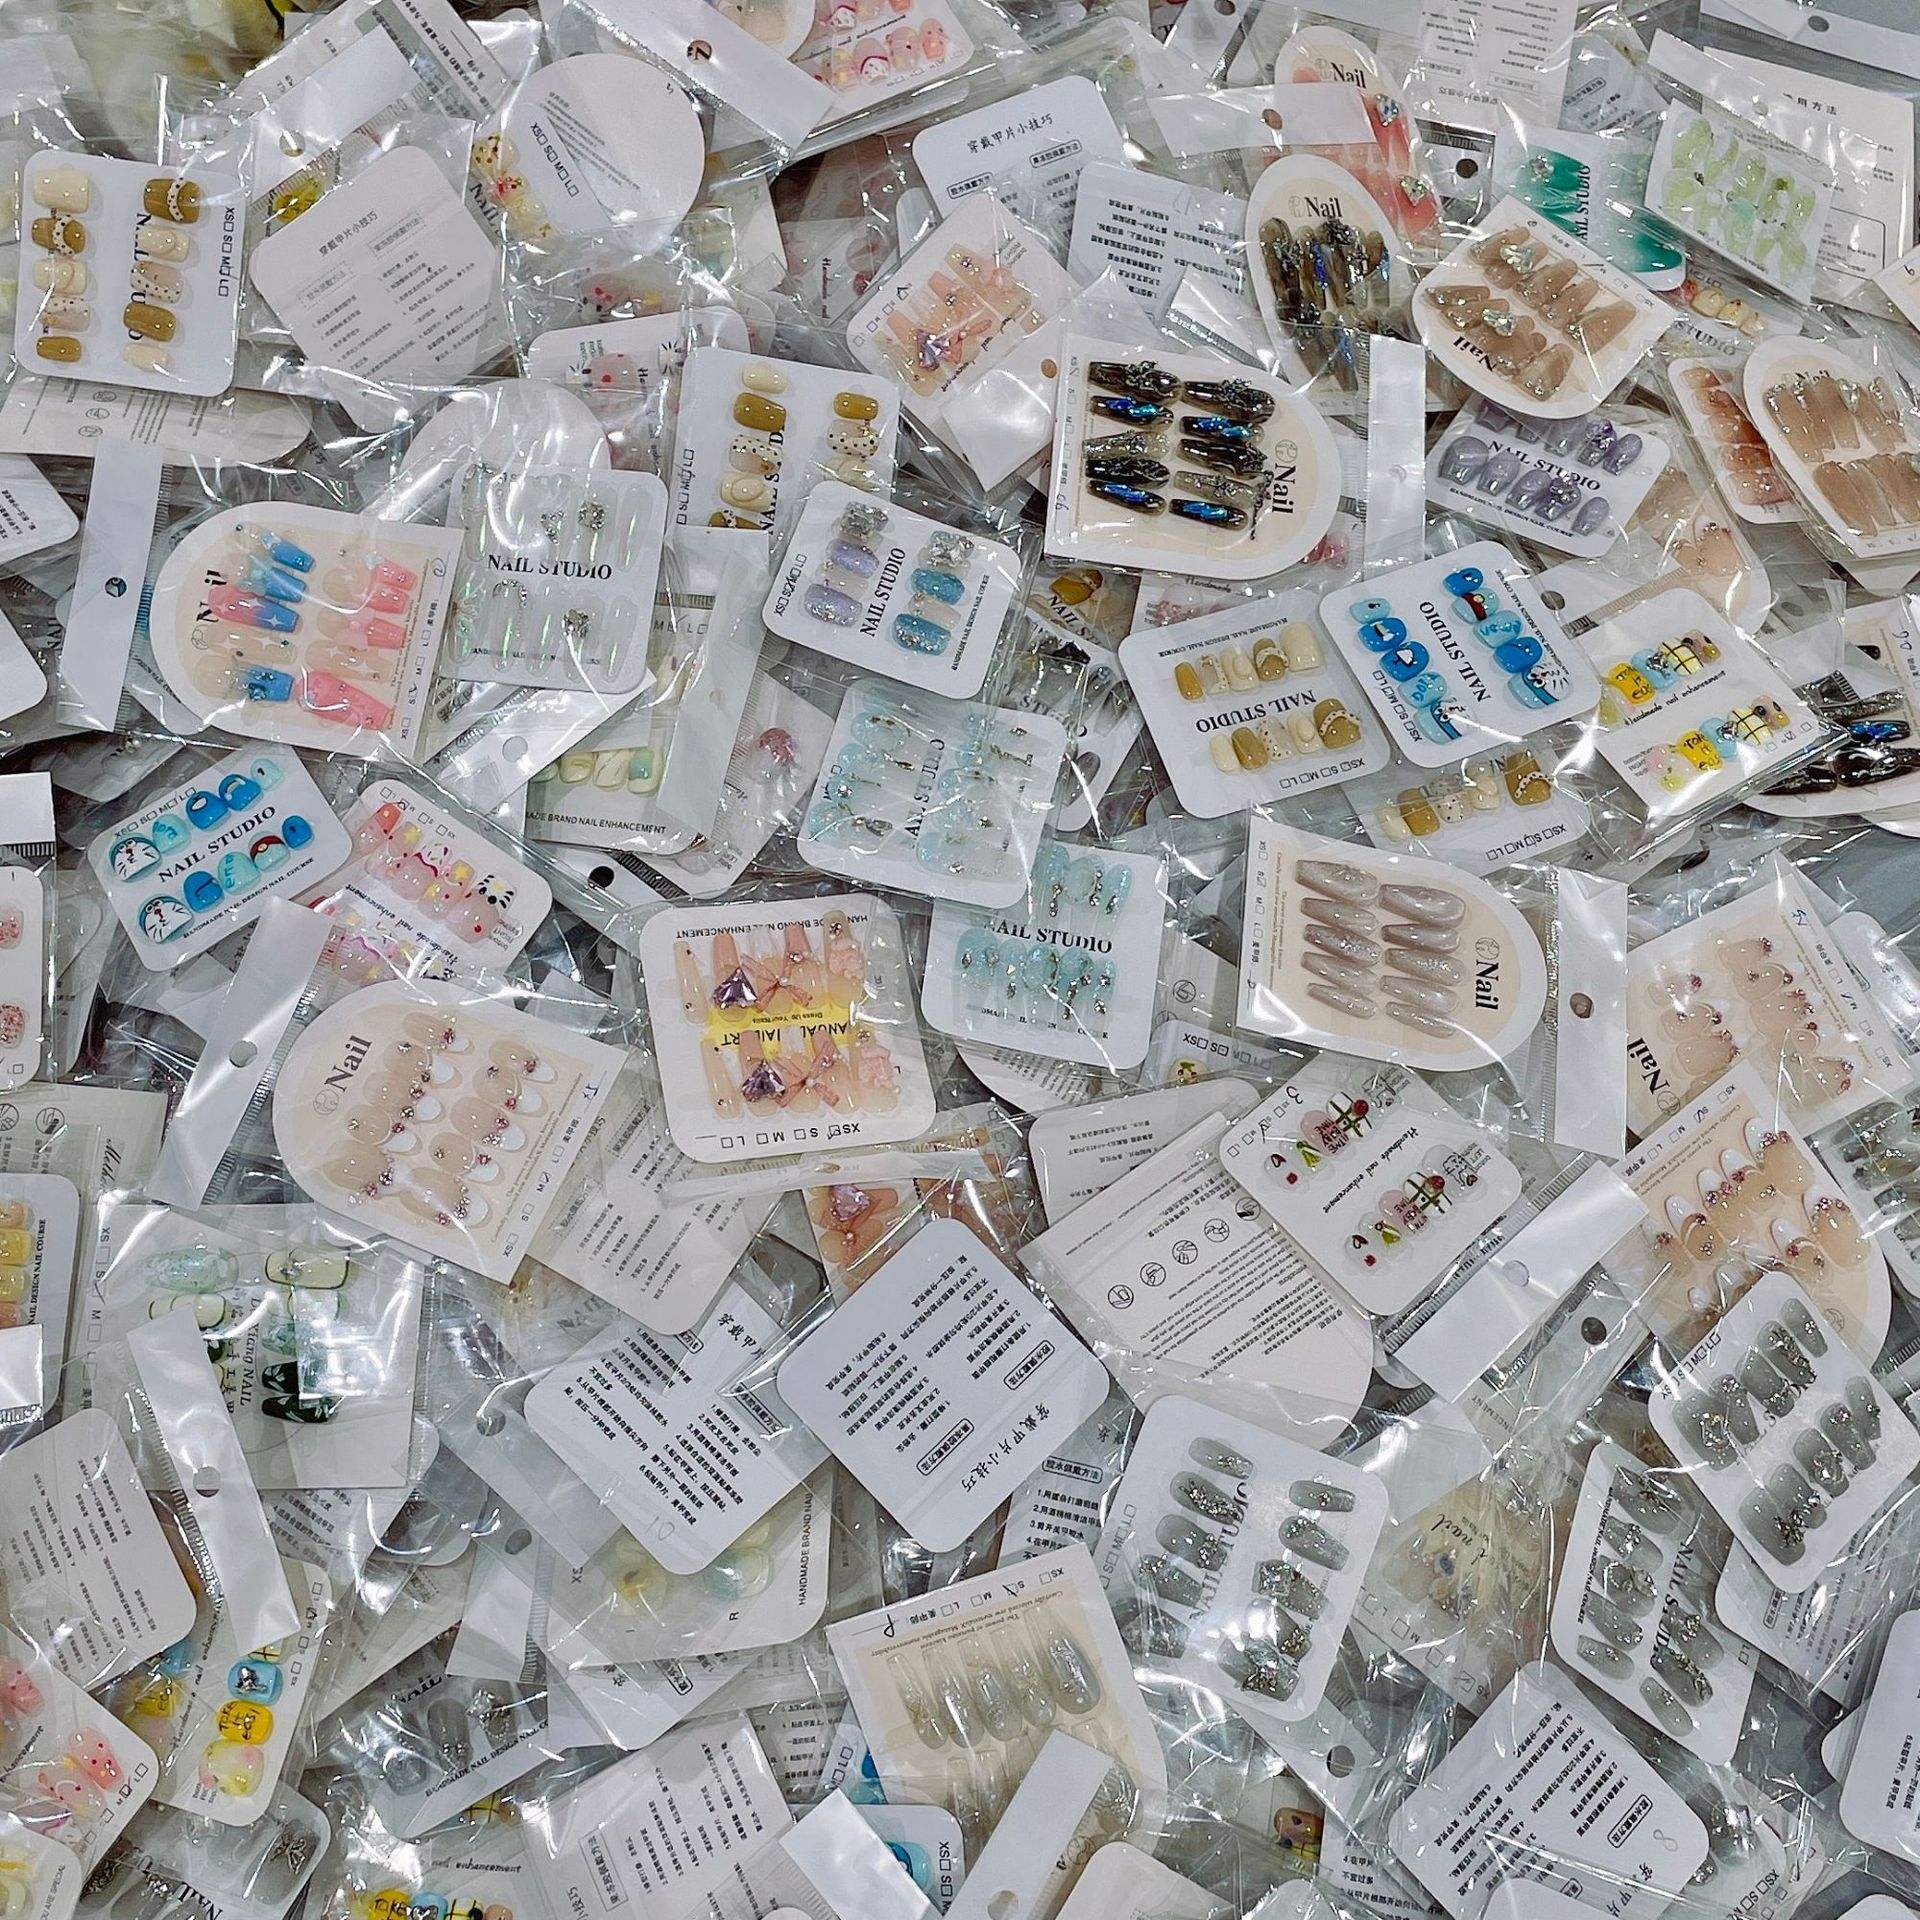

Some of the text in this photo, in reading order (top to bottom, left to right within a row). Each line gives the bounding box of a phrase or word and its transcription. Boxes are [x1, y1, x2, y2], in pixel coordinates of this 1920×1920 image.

[1330, 62, 1367, 88] Nail
[968, 113, 1053, 153] 穿戴甲片小技巧
[1304, 197, 1343, 218] Nail
[1575, 164, 1591, 214] STUDIO
[318, 210, 378, 257] 穿戴甲片小技巧
[1453, 336, 1498, 372] Nail
[1271, 463, 1297, 514] Nail
[487, 553, 534, 574] NAIL
[195, 569, 229, 625] Nil
[860, 548, 906, 637] NAIL STUDIO
[1420, 601, 1492, 702] NAIL STUDIO
[1682, 670, 1727, 699] enhancement
[1196, 690, 1316, 733] NAIL STUDIO
[548, 814, 666, 834] BRAND NAIL ENHANCEMENT
[159, 806, 276, 883] NAIL STUDIO
[677, 923, 751, 939] ENHANCEMENT
[1036, 928, 1113, 954] STUDIO
[1475, 960, 1500, 1011] Nail
[324, 1034, 373, 1093] Nail
[1627, 1037, 1669, 1095] Nail
[842, 1122, 860, 1134] XS
[37, 1219, 46, 1244] COURSE
[1006, 1343, 1052, 1386] 胶水佩戴方法
[239, 1367, 255, 1406] NAIL
[962, 1402, 1050, 1492] 穿戴甲片小技巧
[801, 1513, 811, 1547] BRAND
[571, 1568, 584, 1584] XS
[797, 1548, 809, 1605] HANDMADE
[939, 1842, 950, 1857] XS
[1766, 1869, 1780, 1884] XS
